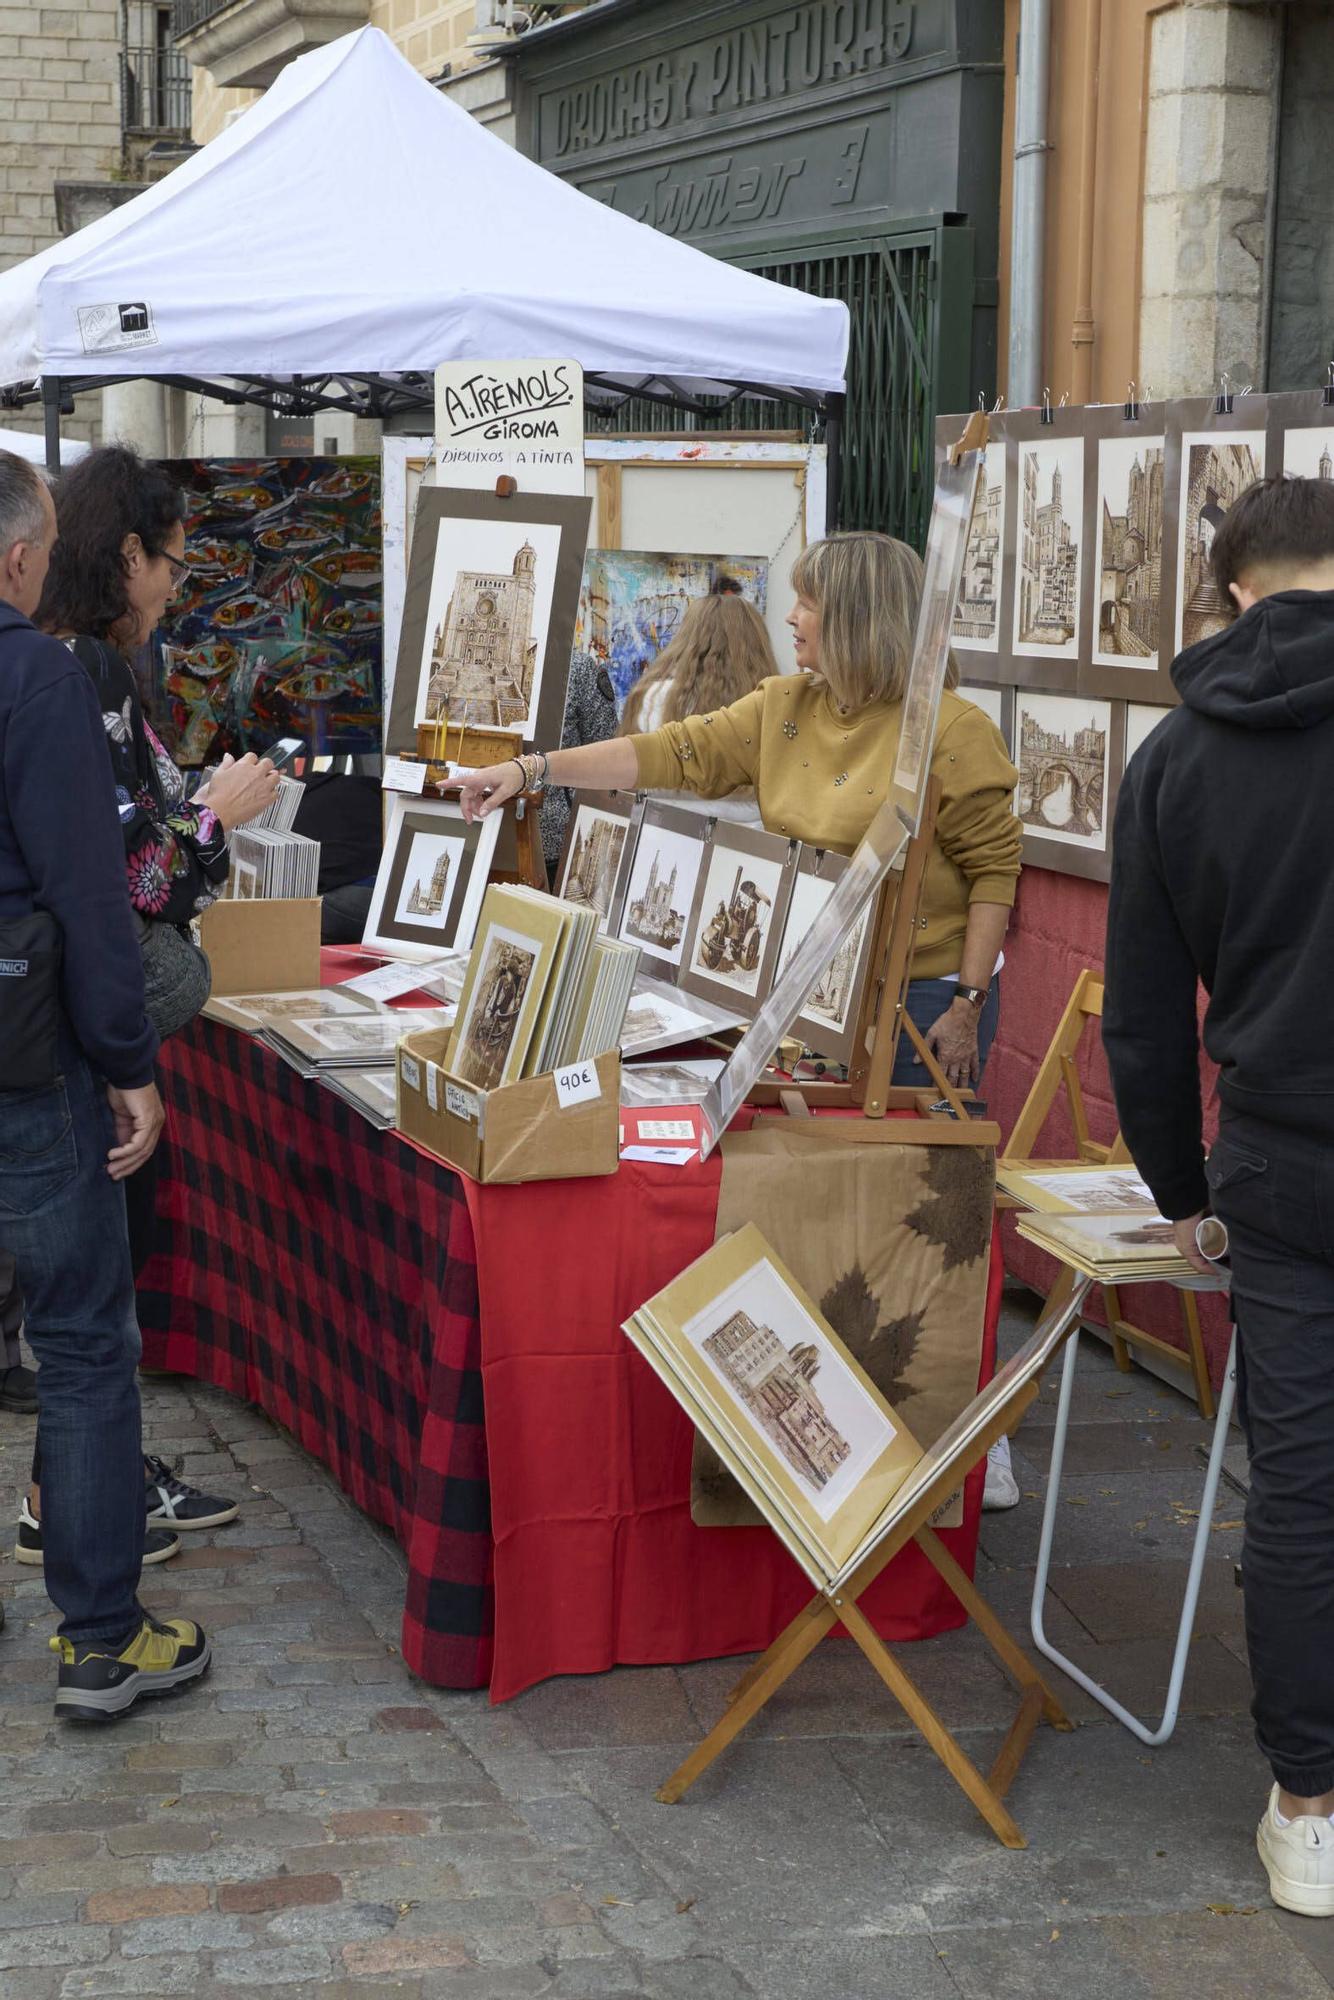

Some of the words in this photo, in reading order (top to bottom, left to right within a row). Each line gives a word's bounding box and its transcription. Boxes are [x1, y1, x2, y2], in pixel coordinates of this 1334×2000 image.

[555, 58, 673, 158] DROGAS
[673, 60, 698, 121] Y
[706, 0, 915, 116] PINTURAS
[516, 452, 526, 464] A
[560, 1069, 592, 1091] 90€
